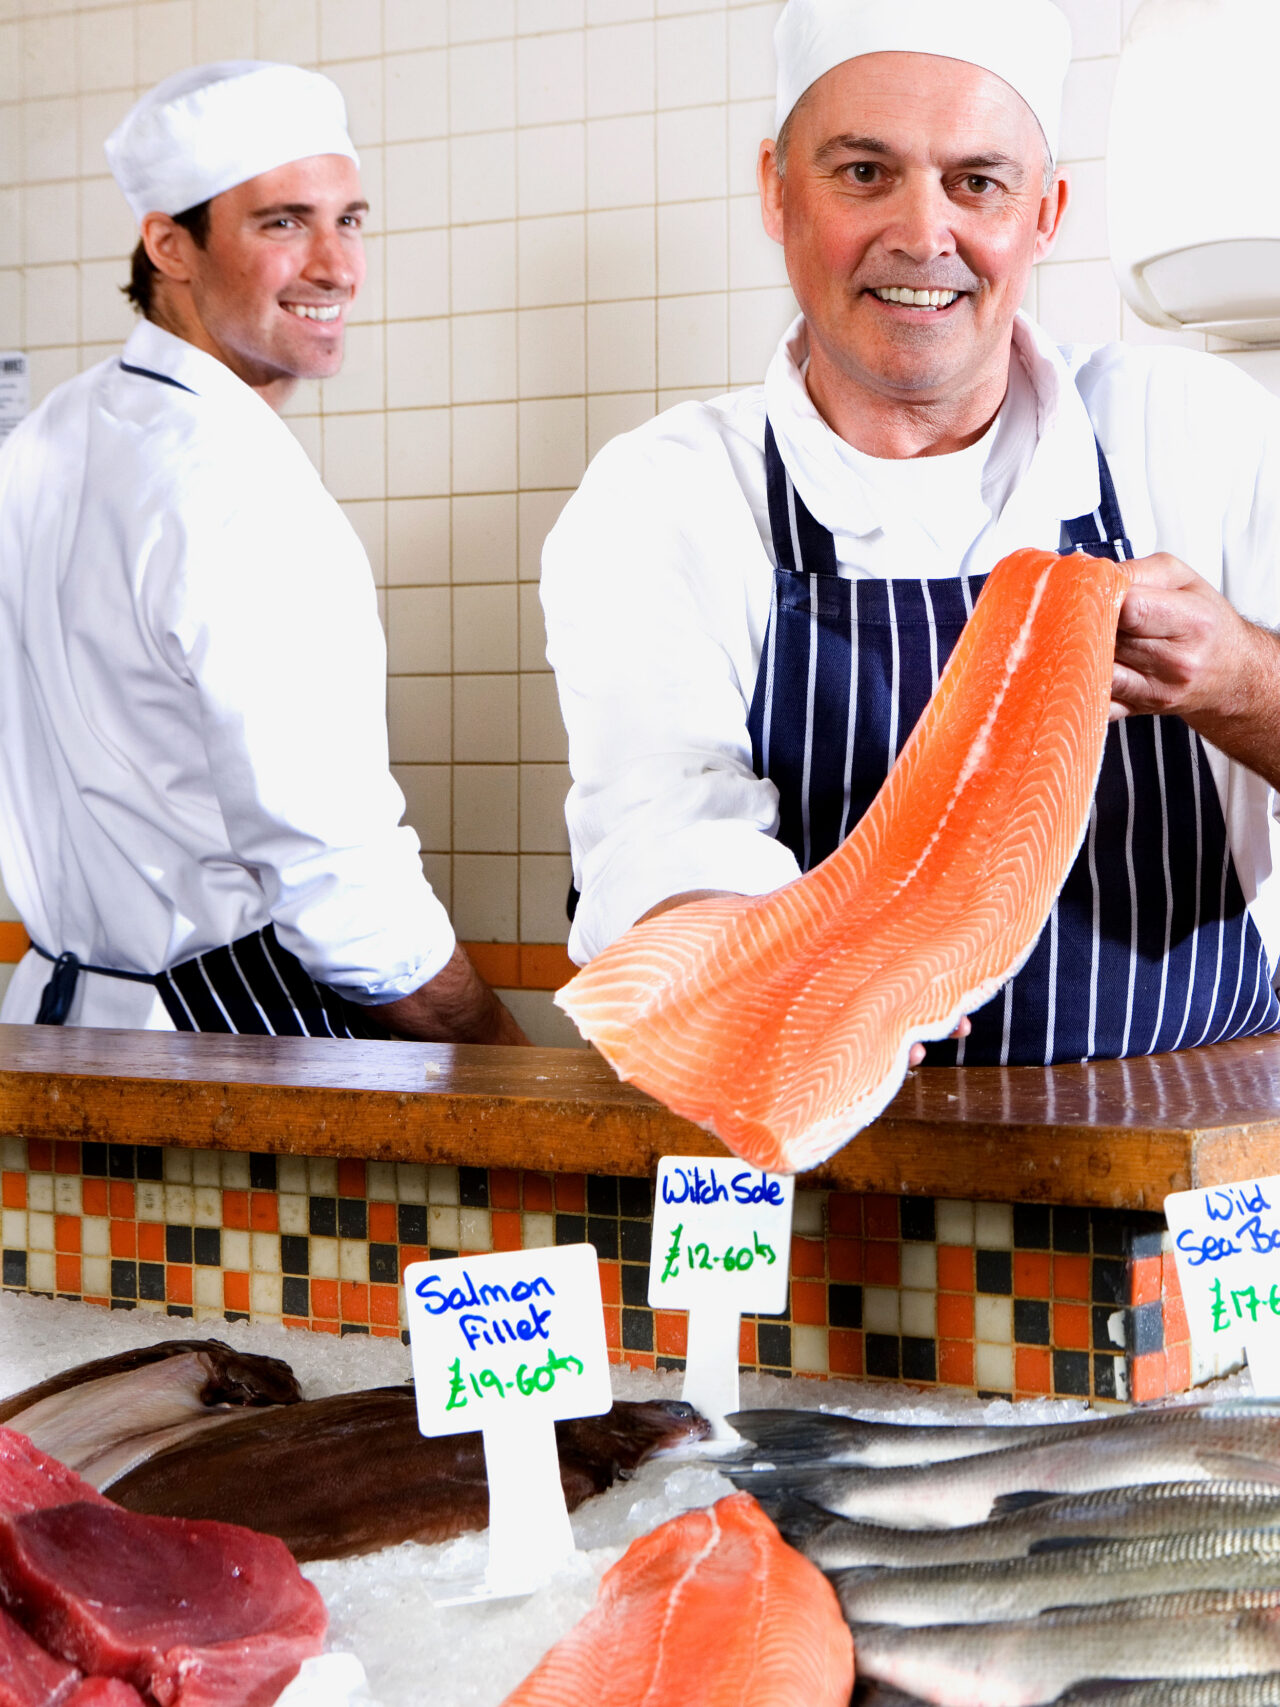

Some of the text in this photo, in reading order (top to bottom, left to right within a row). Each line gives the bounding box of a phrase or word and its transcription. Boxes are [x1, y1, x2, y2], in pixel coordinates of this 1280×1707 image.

[662, 1166, 785, 1206] Witch Sole
[1205, 1184, 1271, 1221] Wild
[1176, 1229, 1242, 1266] Sea
[415, 1270, 555, 1315] Salmon
[458, 1303, 552, 1351] Fillet
